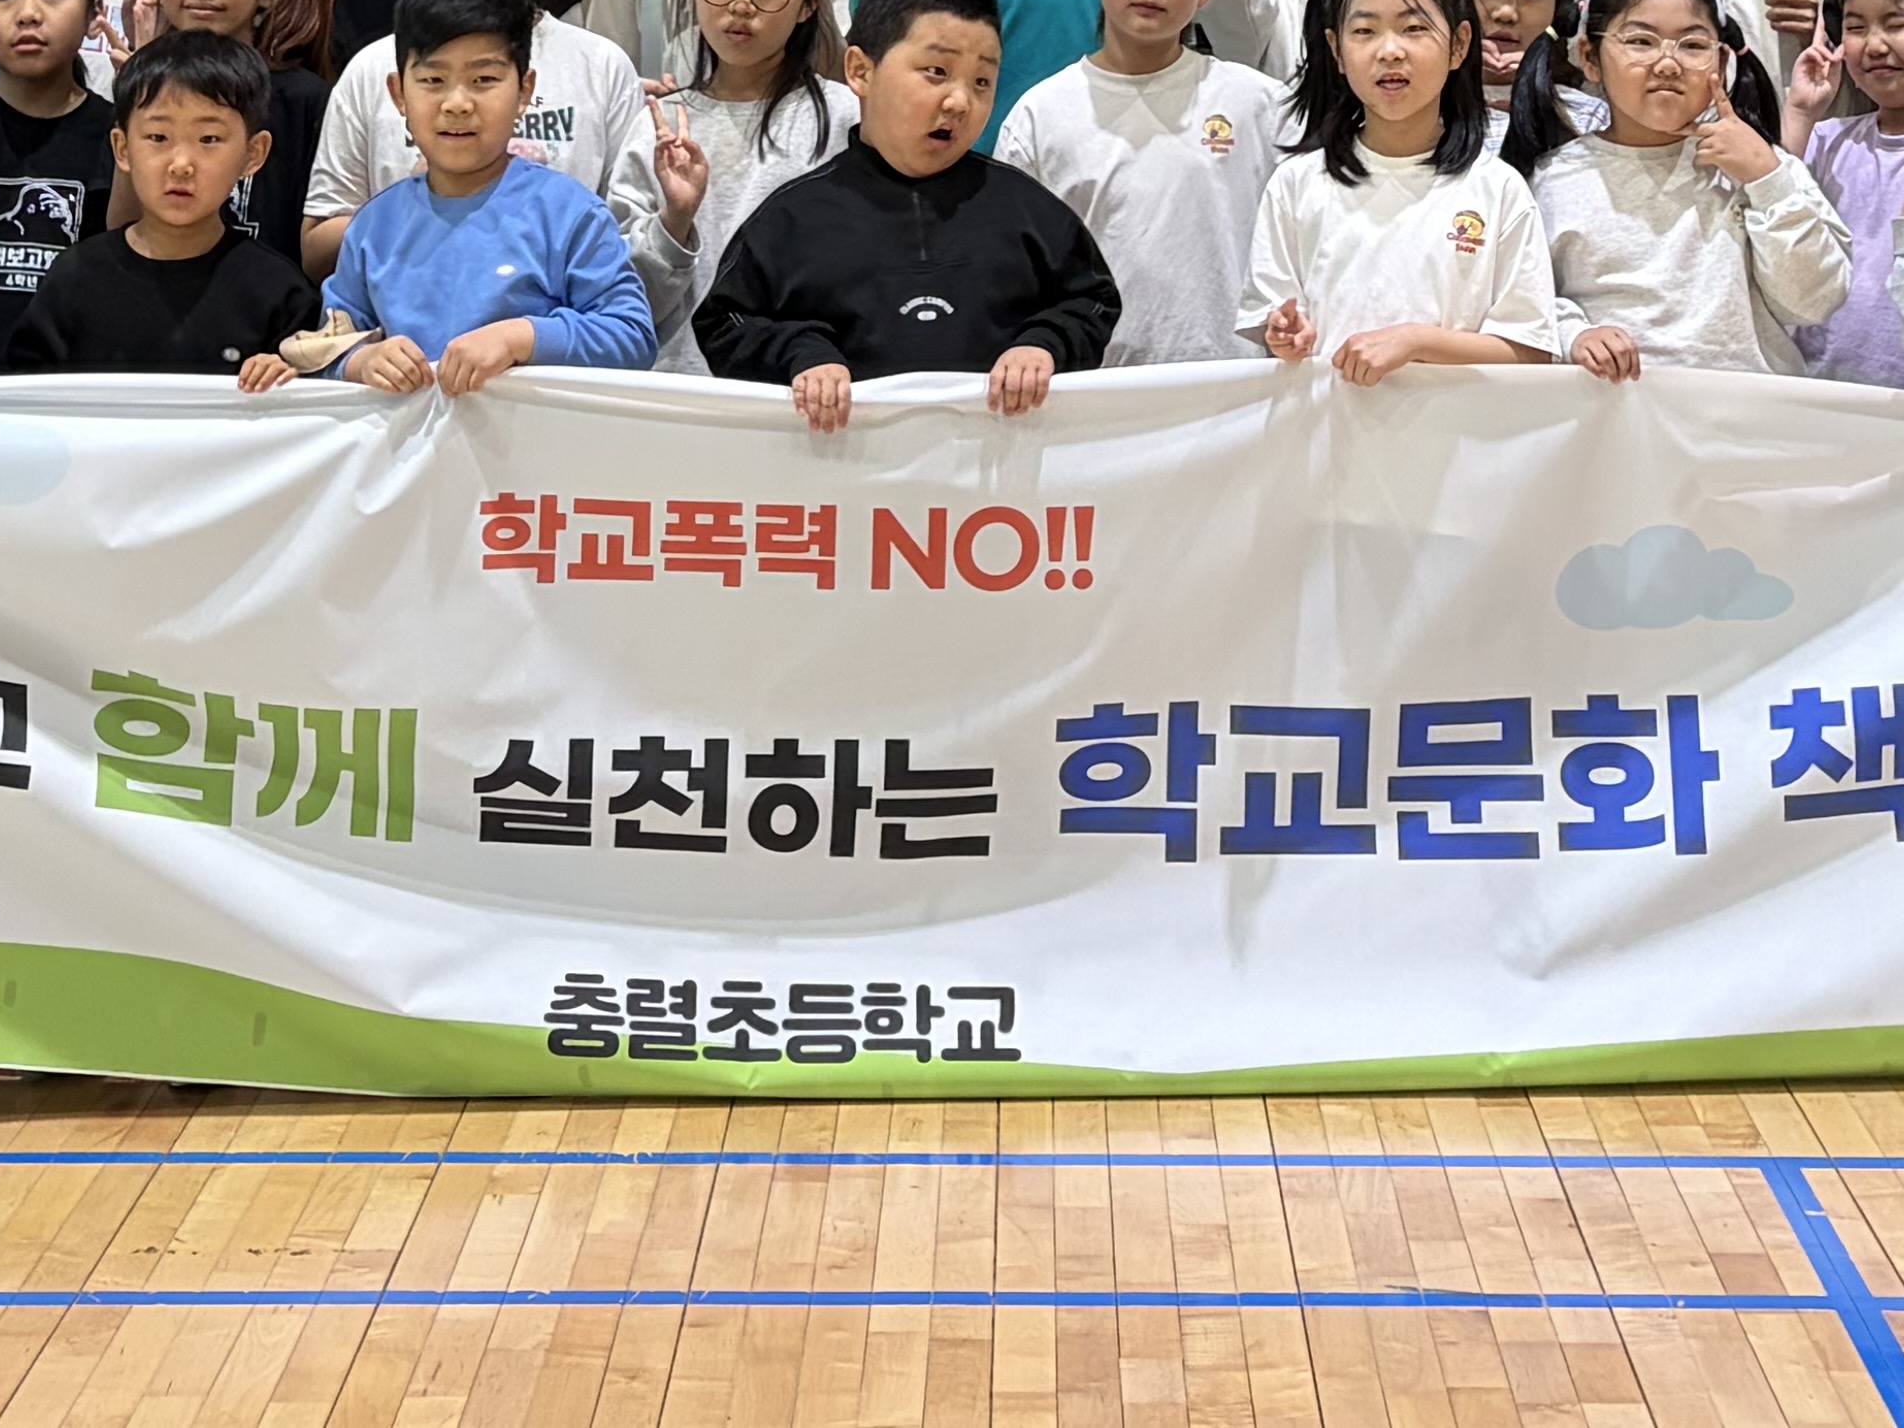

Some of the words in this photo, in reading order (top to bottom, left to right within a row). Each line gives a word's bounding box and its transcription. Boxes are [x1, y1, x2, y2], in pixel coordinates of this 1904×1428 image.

[479, 492, 837, 590] 학교폭력
[871, 505, 1094, 592] NO!!
[92, 668, 416, 842] 함께
[473, 735, 998, 860] 실천하는
[1055, 693, 1719, 862] 학교문화
[543, 973, 1021, 1064] 충렬초등학교
